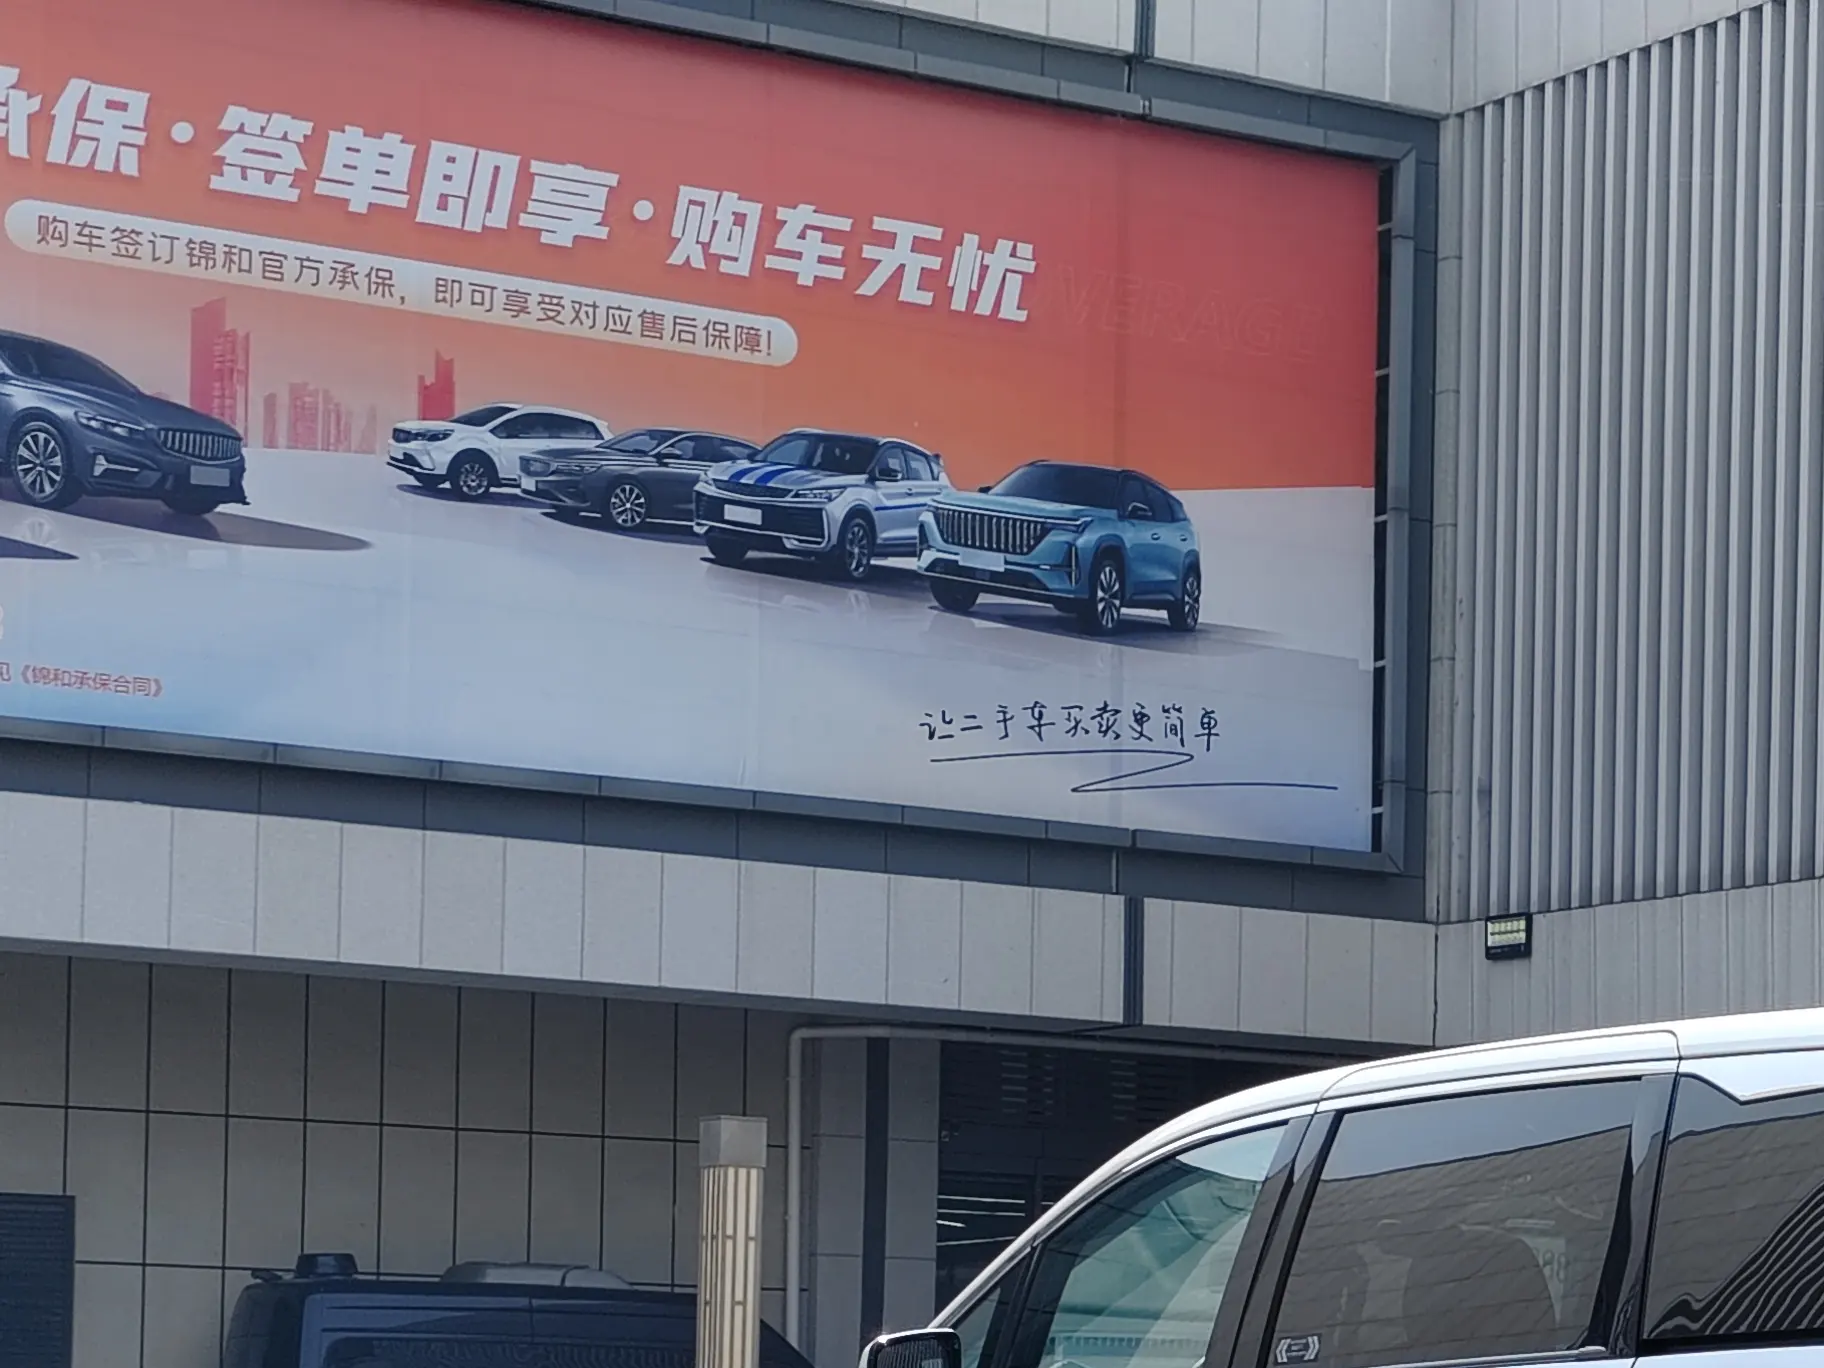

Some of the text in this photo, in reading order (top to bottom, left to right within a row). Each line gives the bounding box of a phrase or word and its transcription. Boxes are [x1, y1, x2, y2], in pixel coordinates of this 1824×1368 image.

[919, 700, 1221, 752] 让二手车买卖更简单
